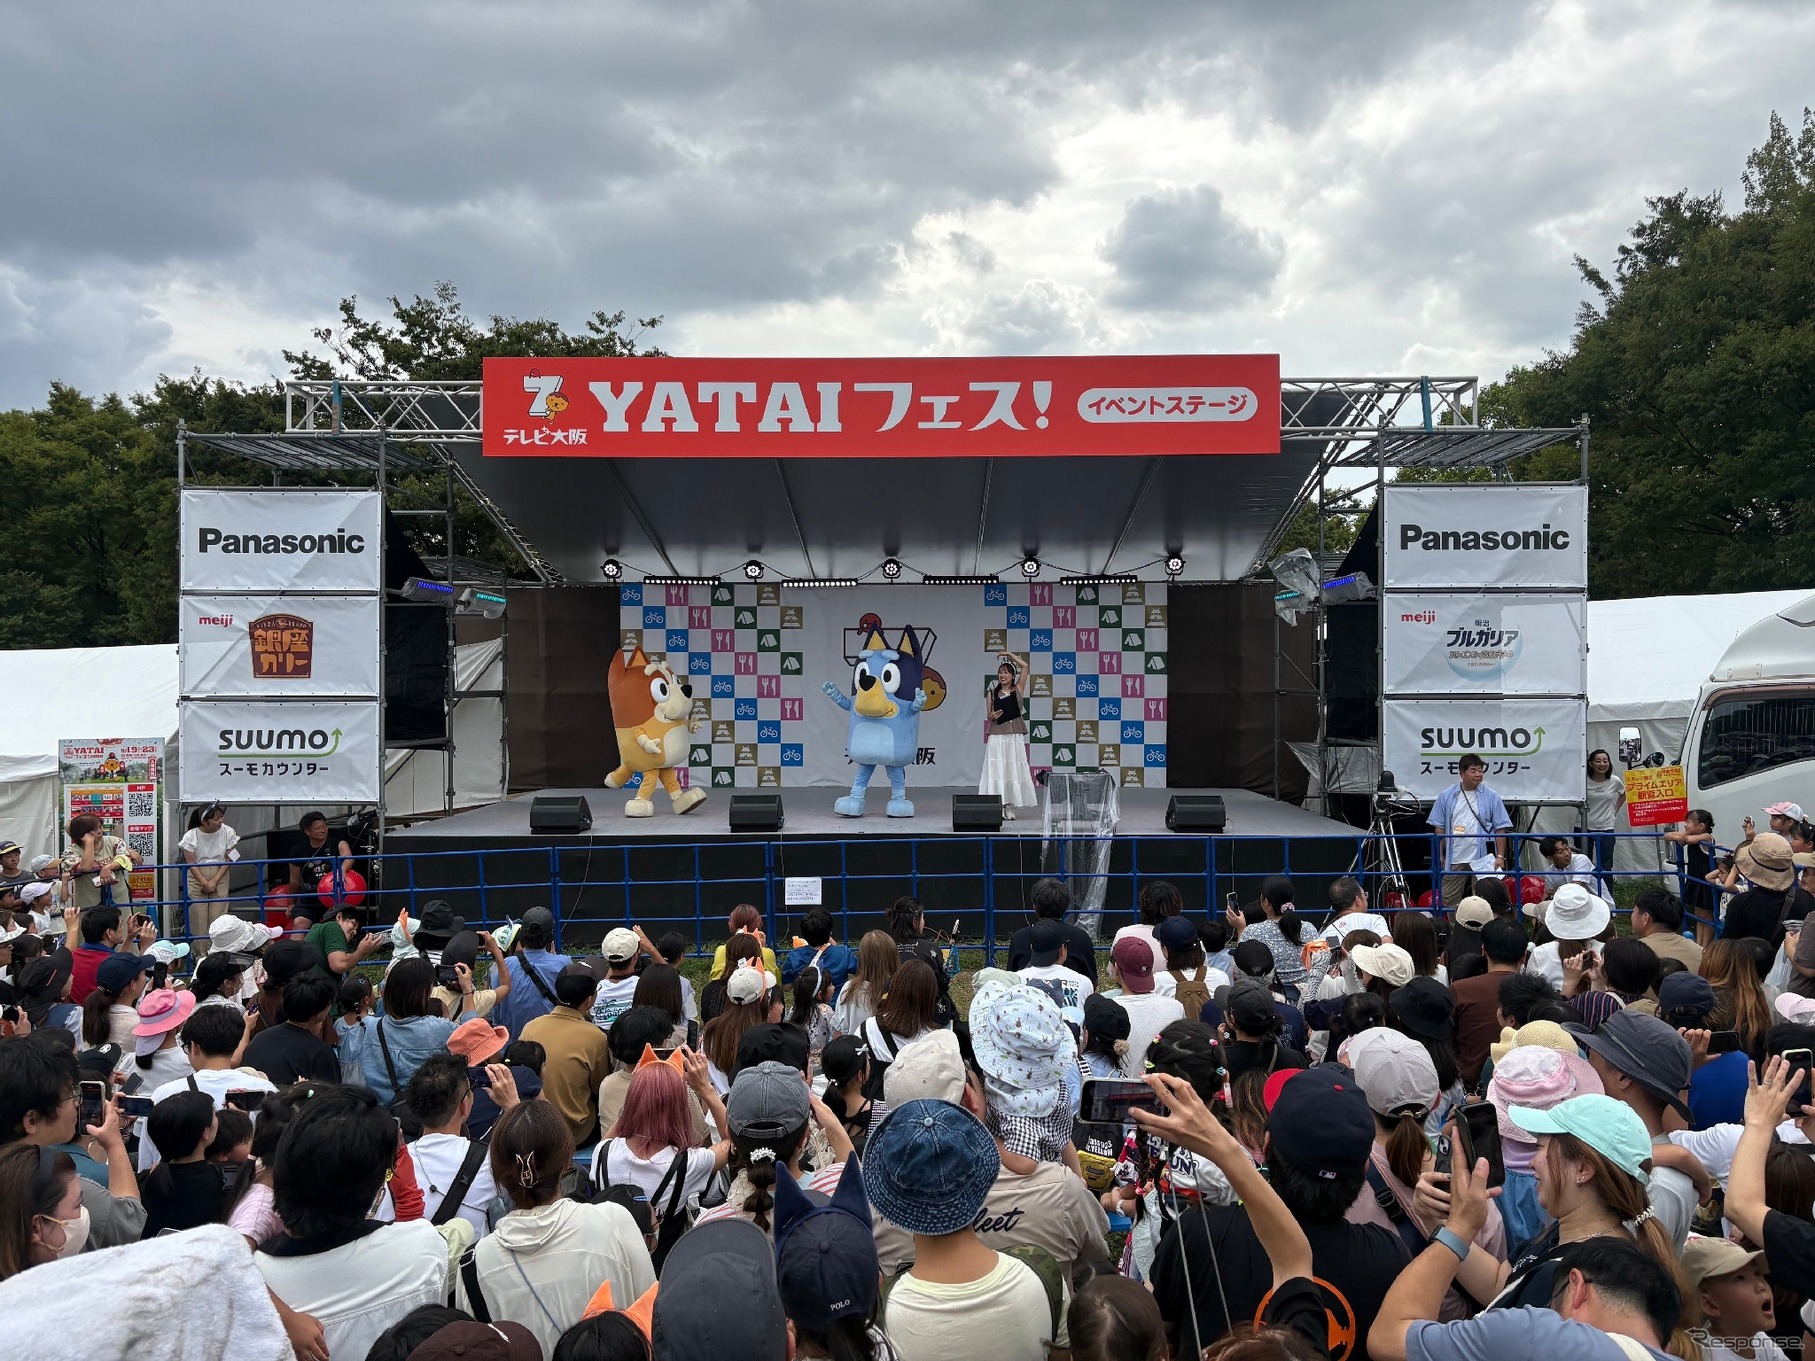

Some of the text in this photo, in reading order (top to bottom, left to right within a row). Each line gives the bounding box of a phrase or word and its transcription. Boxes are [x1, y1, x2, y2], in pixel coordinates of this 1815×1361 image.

[588, 380, 1052, 433] YATAI フェス!
[1088, 394, 1248, 416] イベントステージ
[503, 426, 588, 446] テレビ大阪
[198, 527, 365, 554] Panasonic
[1400, 523, 1570, 551] Panasonic
[198, 614, 234, 628] meiji
[1401, 610, 1436, 625] meiji
[1474, 619, 1490, 627] 明治
[253, 628, 309, 653] 銀座
[1446, 627, 1520, 648] ブルガリア
[260, 653, 309, 674] カリー
[219, 762, 329, 776] スーモカウンター
[1626, 779, 1682, 792] プライムエリア
[1637, 788, 1674, 800] 観覧入口
[972, 1207, 1025, 1233] leet
[830, 1299, 851, 1312] POLO
